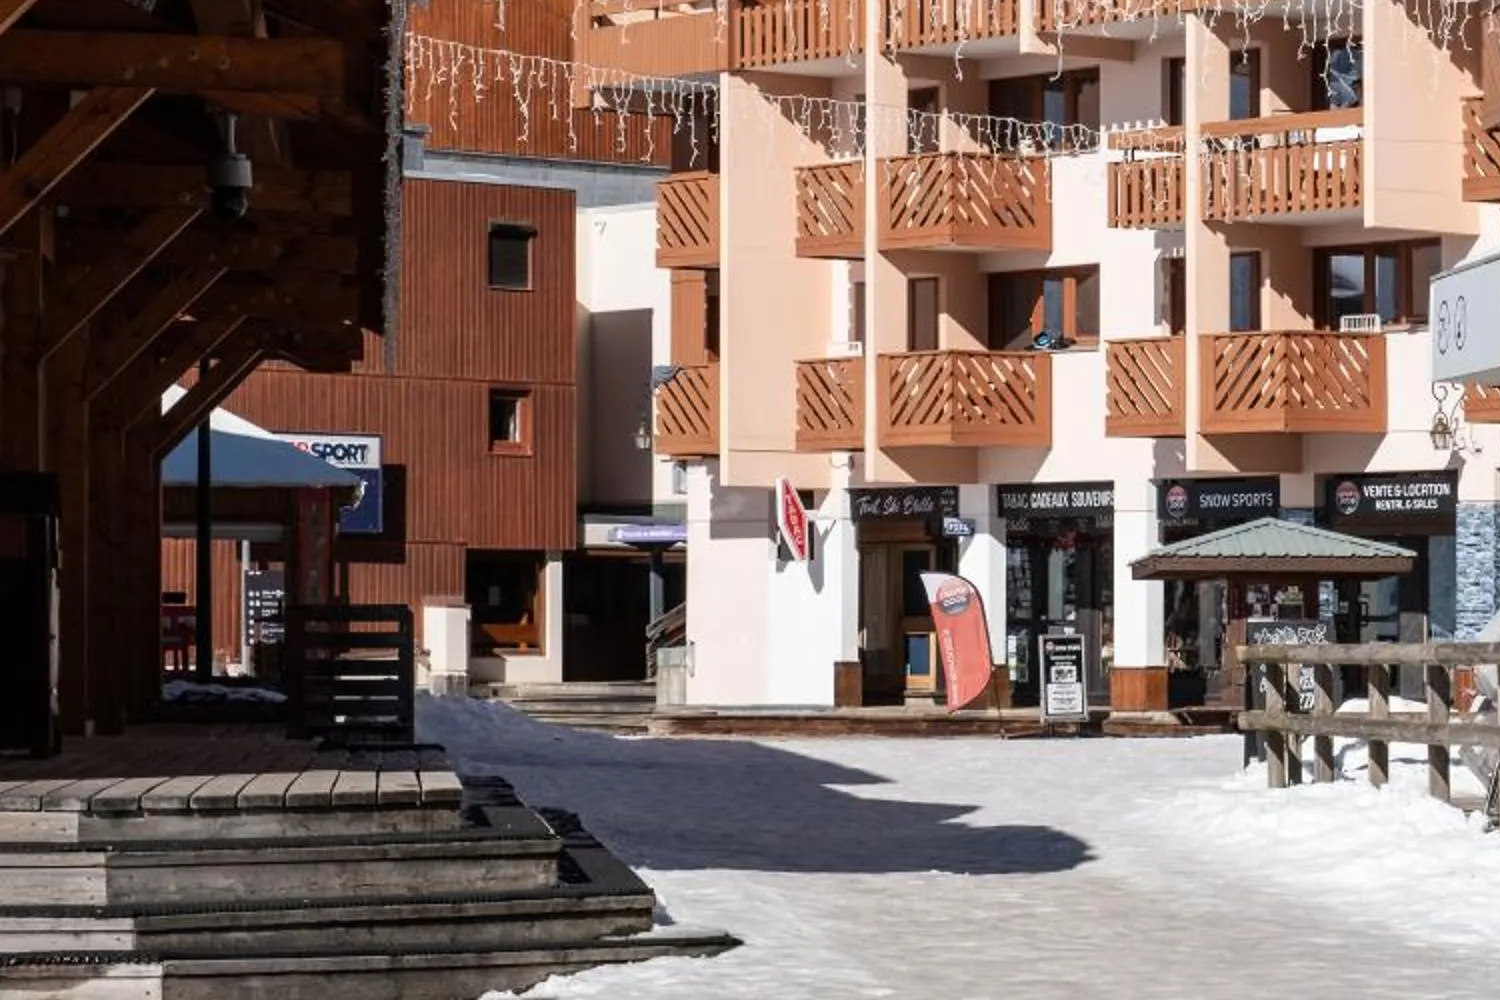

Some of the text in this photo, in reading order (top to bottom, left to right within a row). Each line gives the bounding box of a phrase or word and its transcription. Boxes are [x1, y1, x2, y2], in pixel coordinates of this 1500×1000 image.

[293, 440, 368, 462] SPORT
[1029, 490, 1070, 509] CADEAUX
[1363, 485, 1394, 498] VENTE
[1403, 483, 1451, 497] LOCATION
[1200, 494, 1231, 509] SNOW
[1231, 492, 1274, 508] SPORTS
